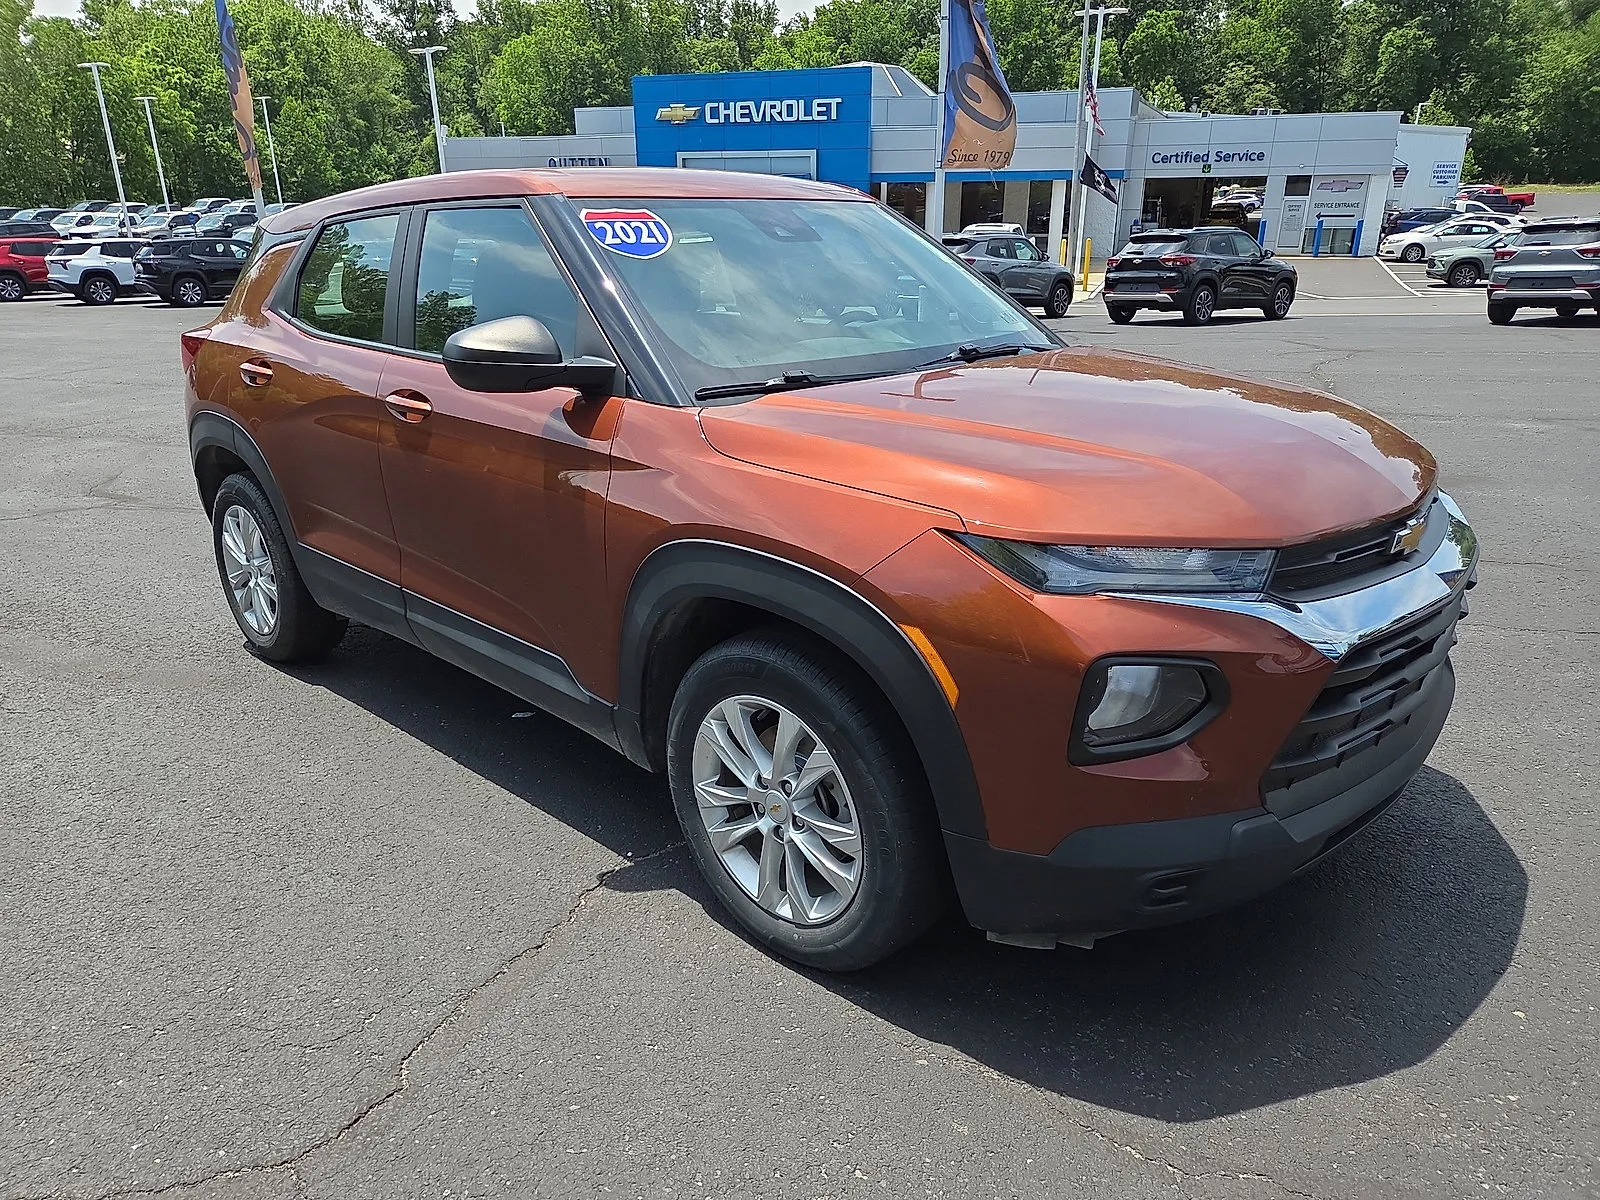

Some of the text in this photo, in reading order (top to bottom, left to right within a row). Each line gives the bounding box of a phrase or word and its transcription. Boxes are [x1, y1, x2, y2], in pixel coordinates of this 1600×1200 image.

[705, 98, 842, 123] CHEVROLET
[947, 148, 1010, 164] Since 1979
[1151, 149, 1265, 164] Certified Service
[1334, 201, 1360, 209] ENTRANCE
[593, 221, 667, 245] 2021
